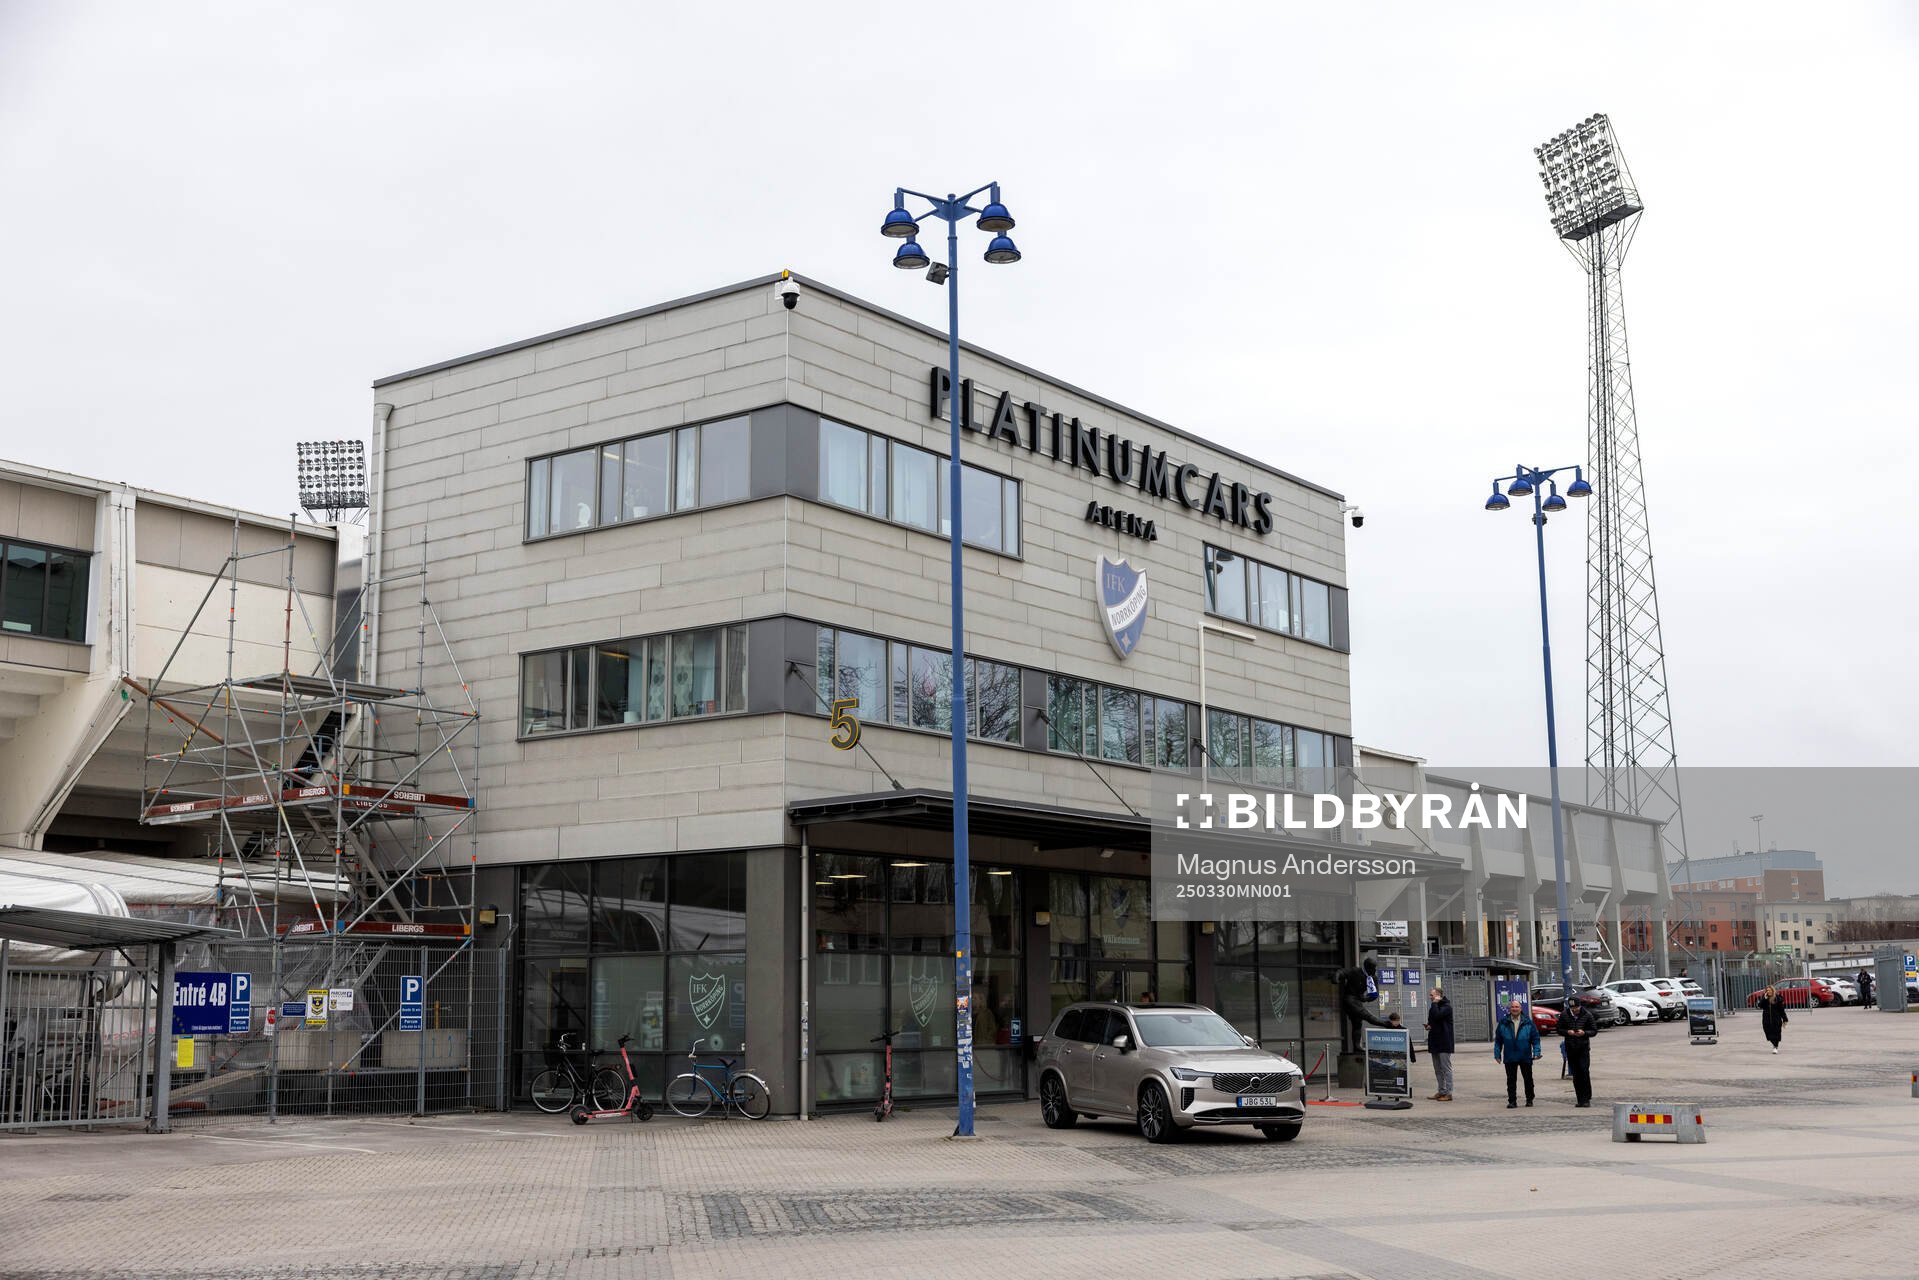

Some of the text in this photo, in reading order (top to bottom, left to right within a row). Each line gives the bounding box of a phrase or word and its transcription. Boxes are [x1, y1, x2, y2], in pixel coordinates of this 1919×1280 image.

[930, 366, 1274, 535] PLATINUMCARS
[1085, 500, 1158, 541] ARENA
[1106, 573, 1127, 594] IFK
[1111, 585, 1147, 627] NORRKÖPING
[831, 697, 860, 750] 5
[299, 786, 326, 797] LIBERGS
[392, 924, 424, 933] LIBERGS
[1906, 956, 1914, 965] P
[172, 982, 227, 1007] Entré 4B
[235, 976, 248, 1000] P
[406, 978, 420, 1001] P
[693, 983, 707, 994] IFK
[1245, 1097, 1259, 1106] JBG
